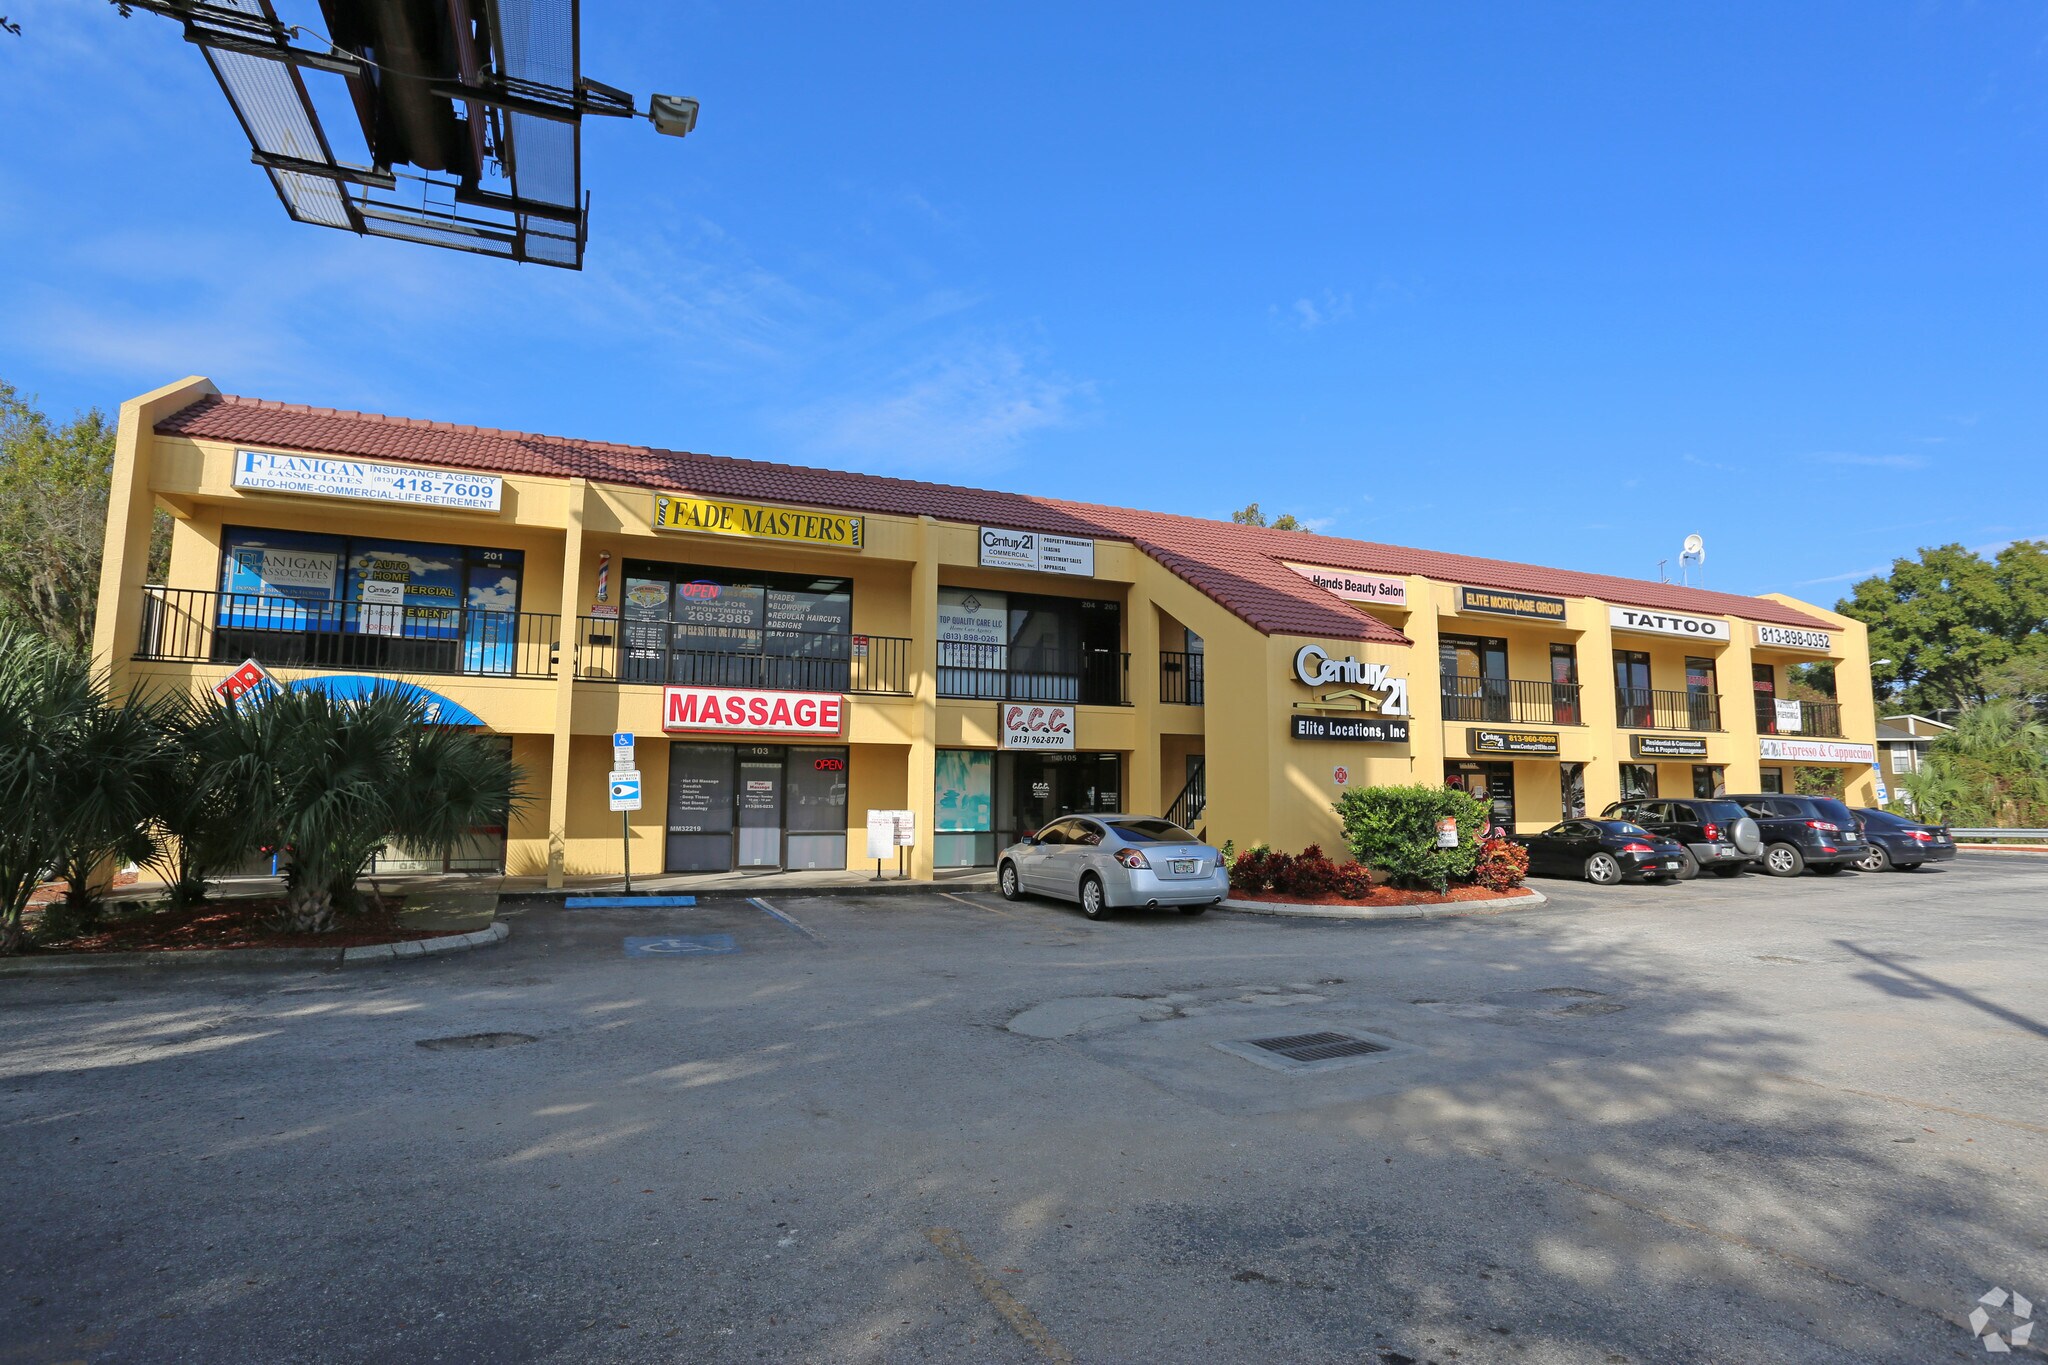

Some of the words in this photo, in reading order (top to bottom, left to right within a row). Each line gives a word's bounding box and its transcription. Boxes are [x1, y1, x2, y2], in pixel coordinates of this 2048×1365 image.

[242, 453, 364, 477] FLANIGAN
[275, 470, 363, 485] ASSOCIATES
[370, 466, 442, 479] INSURANCE
[445, 474, 496, 484] AGENCY
[374, 476, 394, 484] (813)
[393, 478, 493, 498] 418-7609
[673, 501, 734, 530] FADE
[741, 508, 846, 542] MASTERS
[983, 532, 1022, 550] Century
[1022, 535, 1034, 550] 21
[1065, 540, 1092, 548] MANAGEMENT
[484, 552, 502, 560] 201
[988, 549, 1029, 558] COMMERCIAL
[235, 553, 333, 575] FLANIGAN
[374, 560, 409, 571] AUTO
[998, 560, 1026, 568] LOCATIONS,
[260, 567, 328, 580] ASSOCIATES
[373, 571, 410, 582] HOME
[368, 585, 392, 594] Century
[392, 586, 399, 594] 21
[404, 584, 456, 597] MERCIAL
[683, 584, 718, 598] OPEN
[1313, 575, 1343, 590] Hands
[1344, 579, 1376, 596] Beauty
[1379, 583, 1404, 597] Salon
[774, 594, 796, 602] FADES
[1466, 592, 1490, 607] ELITE
[1490, 596, 1536, 612] MORTGAGE
[1536, 600, 1563, 615] GROUP
[685, 606, 754, 616] APPOINTMENTS
[773, 602, 811, 612] BLOWOUTS
[688, 612, 750, 624] 269-2989
[772, 612, 805, 622] REGULAR
[807, 614, 841, 624] HAIRCUTS
[940, 616, 950, 624] TOP
[952, 616, 975, 626] QUALITY
[976, 619, 990, 627] CARE
[992, 620, 1002, 628] LLC
[1623, 612, 1716, 634] TATTOO
[772, 622, 802, 630] DESIGNS
[943, 632, 961, 641] (813)
[964, 634, 998, 642] 898-0261
[1762, 627, 1830, 648] 813-898-0352
[943, 643, 962, 652] (83)
[1293, 644, 1390, 691] Century
[1380, 678, 1407, 716] 21
[669, 694, 838, 728] MASSAGE
[1006, 706, 1071, 734] C.C.C.
[1298, 720, 1324, 735] Elite
[1330, 722, 1384, 740] Locations,
[1390, 724, 1406, 738] Inc
[1011, 735, 1029, 744] (813)
[1032, 736, 1064, 744] 962-8770
[1480, 732, 1500, 741] Century
[1498, 738, 1504, 746] 21
[1508, 735, 1556, 744] 813-960-0999
[1782, 742, 1817, 760] Expresso
[1820, 744, 1826, 758] &
[1828, 744, 1872, 762] Cappuccino
[814, 759, 844, 770] OPEN
